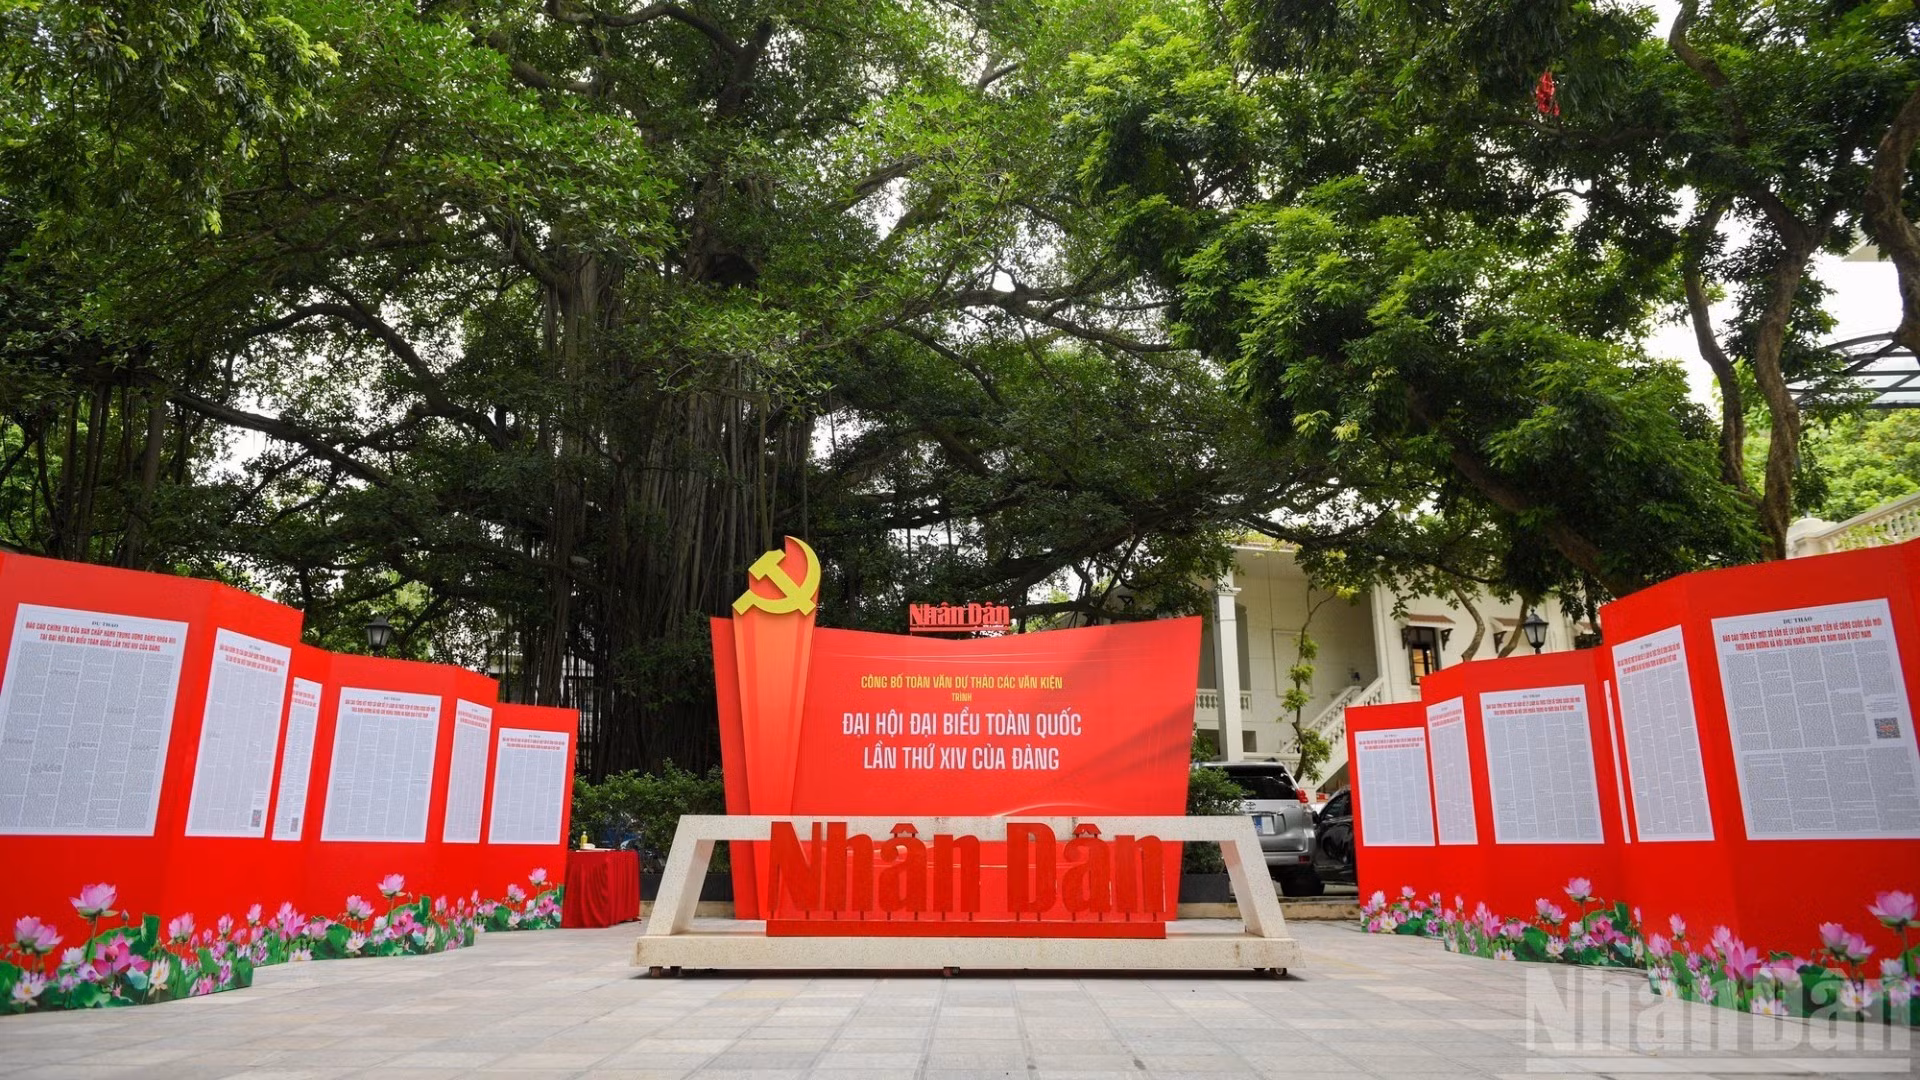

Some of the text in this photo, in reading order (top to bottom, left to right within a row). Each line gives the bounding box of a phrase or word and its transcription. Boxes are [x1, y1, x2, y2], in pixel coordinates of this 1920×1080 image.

[909, 602, 1010, 625] Nhân Dân
[861, 672, 1063, 690] CÔNG BỐ TOÀN VĂN DỰ THẢO CÁC VĂN KIỆN
[952, 691, 972, 702] TRÌNH
[842, 706, 1082, 739] ĐẠI HỘI ĐẠI BIỂU TOÀN QUỐC
[864, 740, 1060, 770] LẦN THỨ XIV CỦA ĐẢNG
[767, 821, 1165, 914] Nhân Dân
